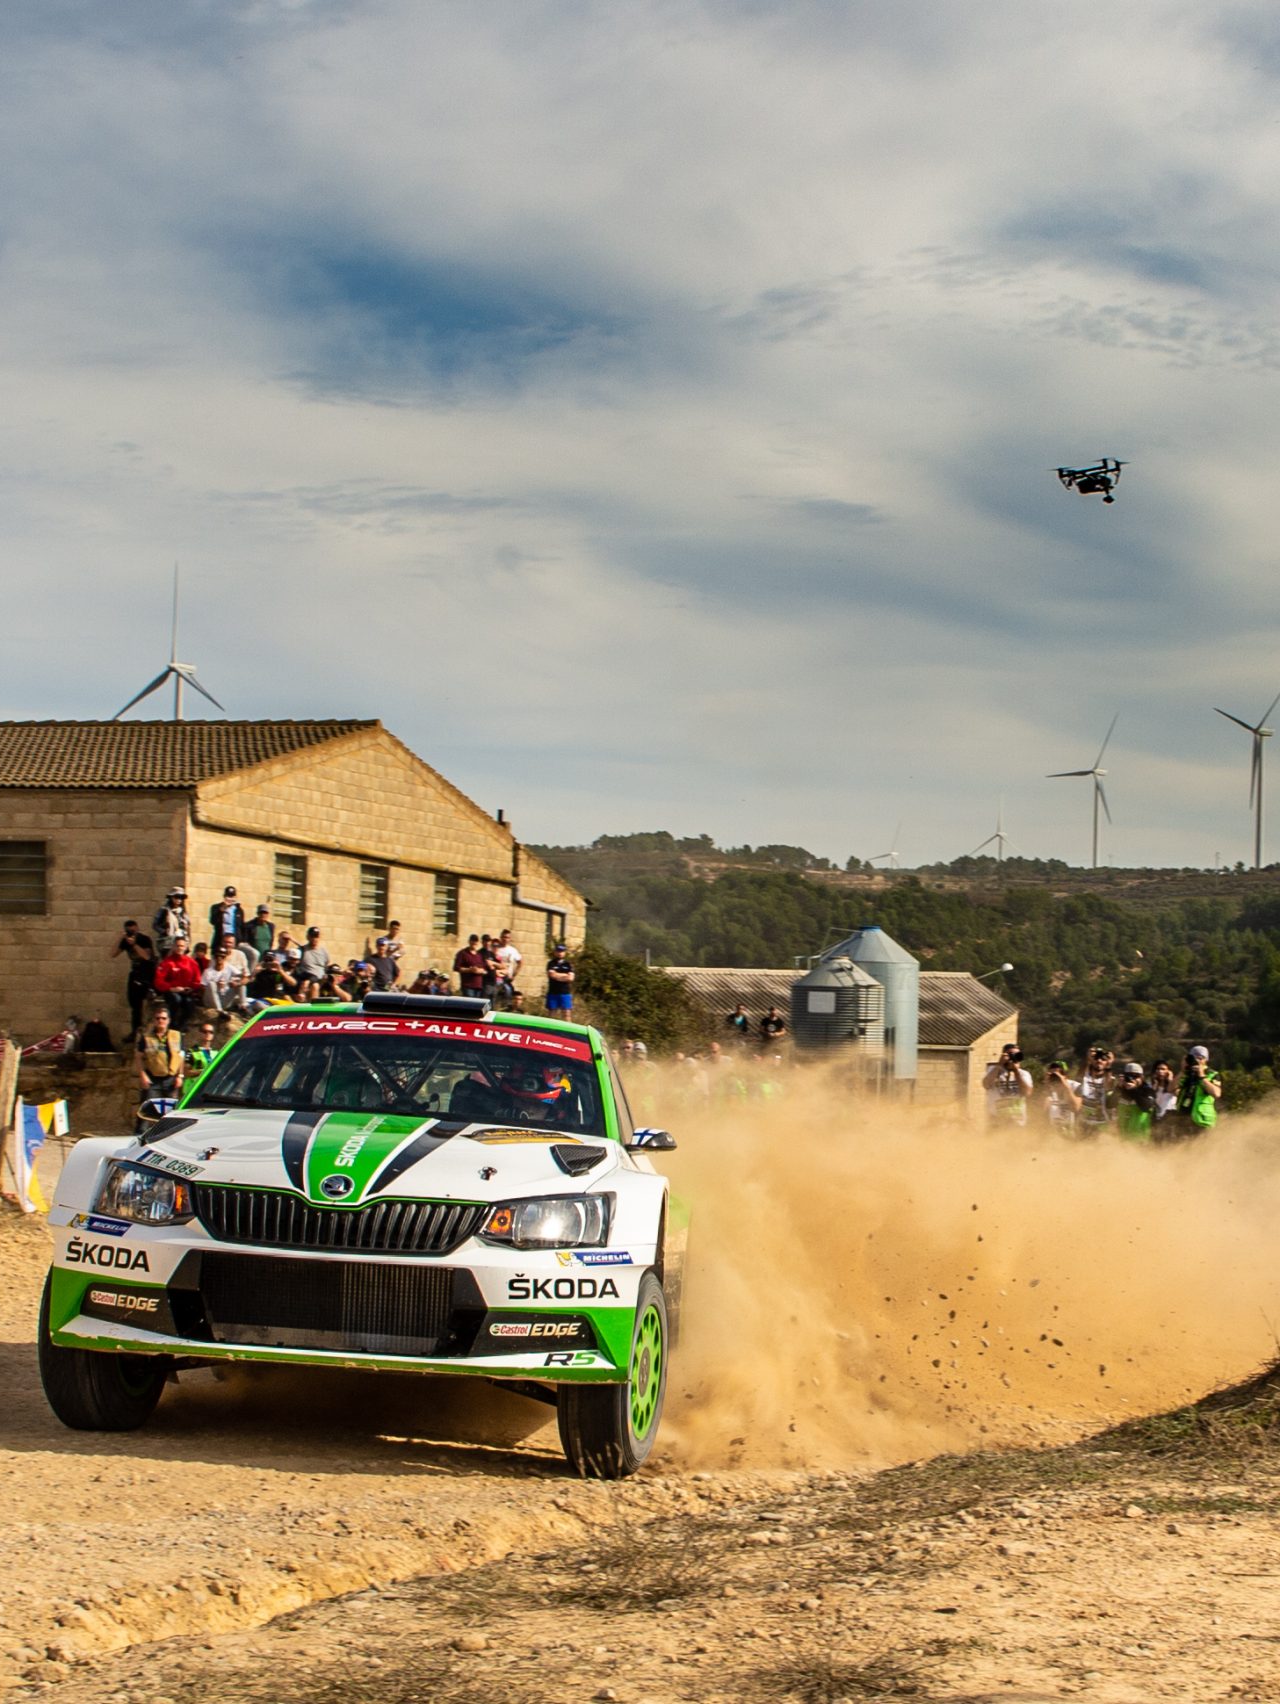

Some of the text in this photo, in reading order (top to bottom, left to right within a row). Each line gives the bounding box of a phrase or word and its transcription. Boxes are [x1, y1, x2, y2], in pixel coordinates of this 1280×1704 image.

[306, 1021, 399, 1031] WRC
[425, 1024, 467, 1036] ALL
[473, 1029, 522, 1044] LIVE
[65, 1236, 150, 1272] ŠKODA
[583, 1253, 630, 1262] MICHELIN
[508, 1273, 620, 1299] ŠKODA
[117, 1294, 160, 1312] EDGE
[500, 1323, 582, 1337] Castrol EDGE
[544, 1353, 596, 1366] R5
